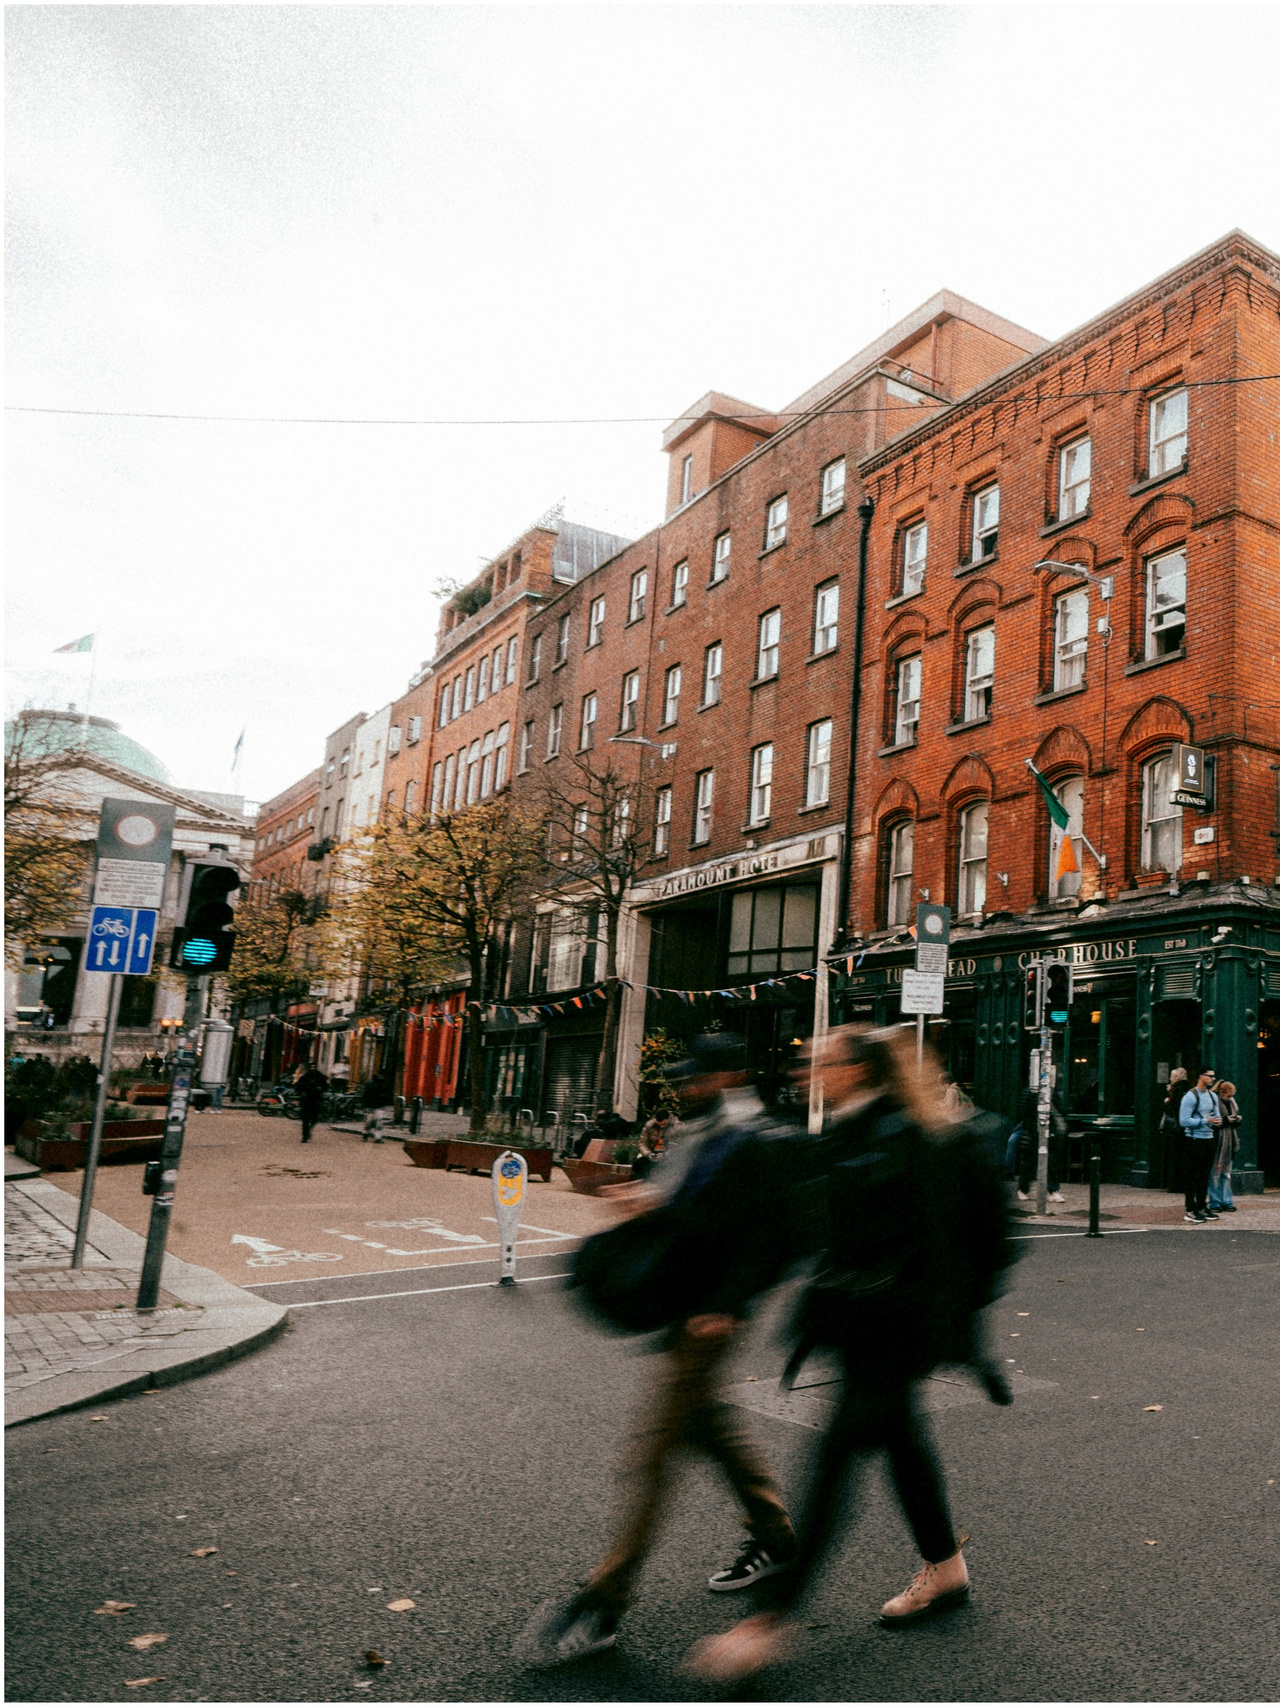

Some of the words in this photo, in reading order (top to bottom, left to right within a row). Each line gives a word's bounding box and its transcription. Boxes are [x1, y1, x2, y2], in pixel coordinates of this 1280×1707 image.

[1177, 793, 1207, 806] GUINNESS
[660, 865, 735, 896] PARAMOUNT
[943, 958, 977, 978] EAD
[1072, 940, 1137, 964] HOUSE
